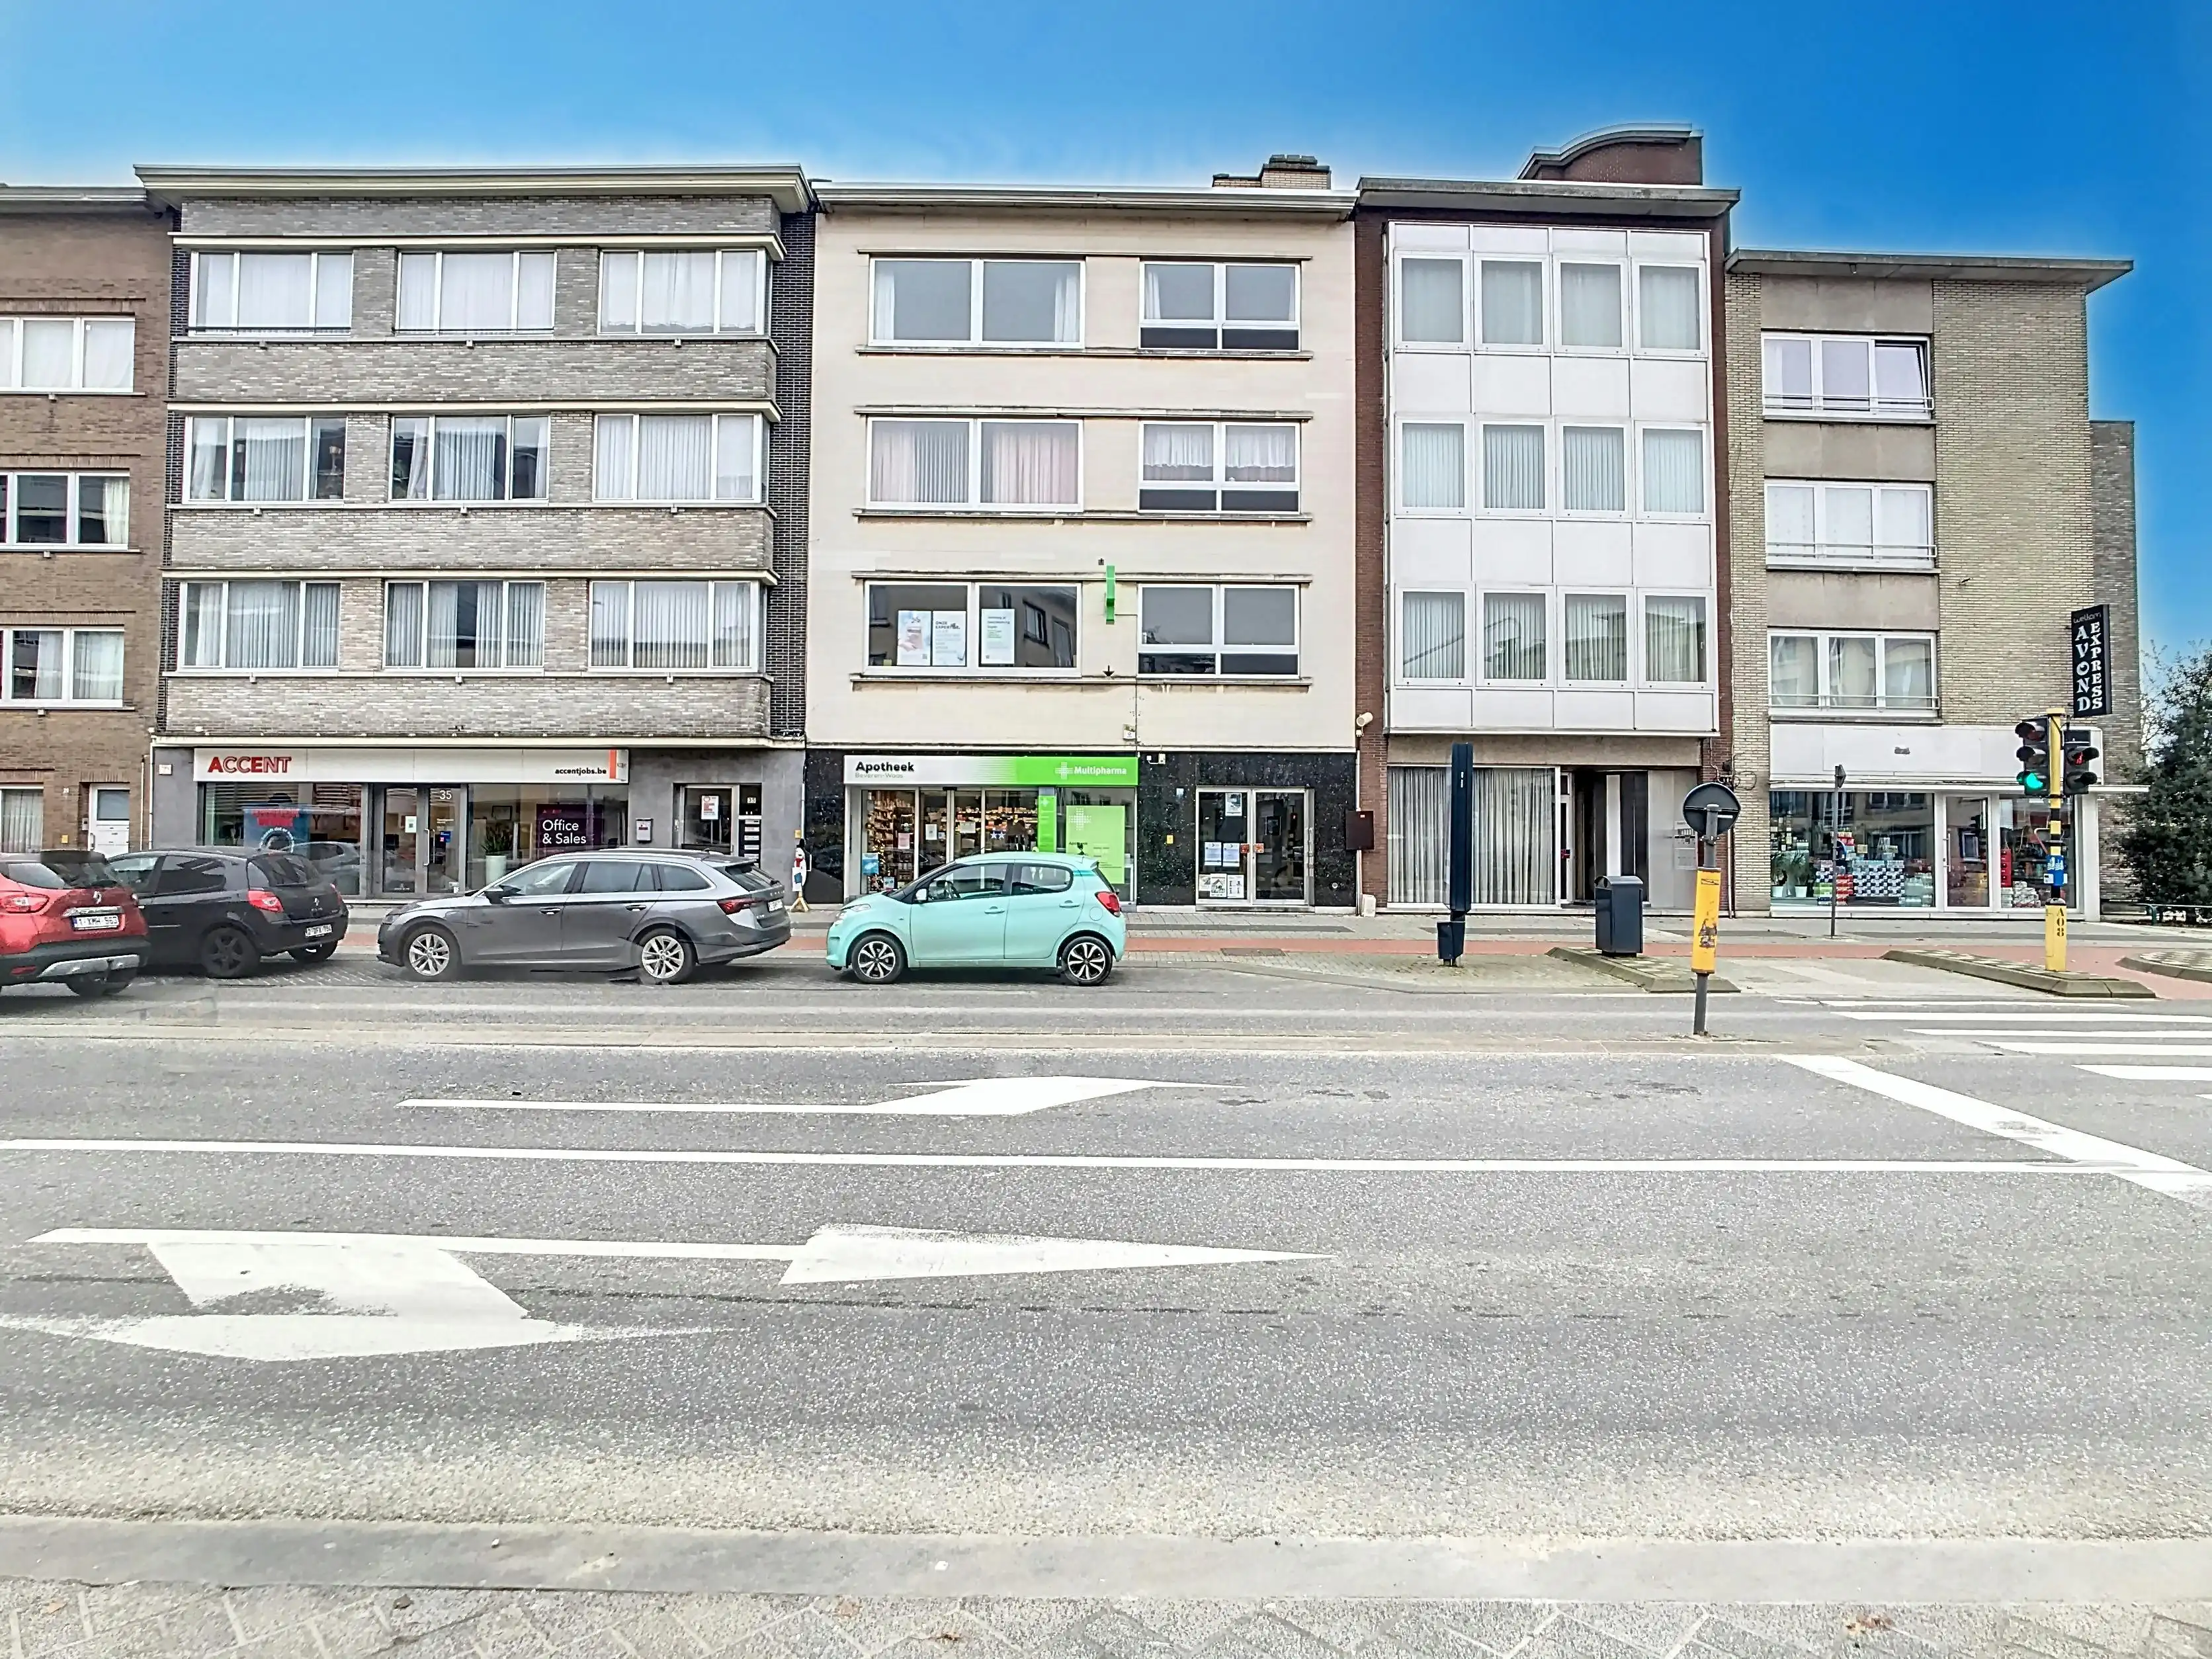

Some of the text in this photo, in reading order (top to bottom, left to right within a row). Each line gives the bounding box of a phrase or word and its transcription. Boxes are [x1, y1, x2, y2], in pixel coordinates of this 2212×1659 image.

[2075, 625, 2091, 712] AVOND
[2090, 622, 2104, 710] EXPRESS
[207, 756, 292, 773] ACCENT
[855, 761, 914, 773] Apotheek
[555, 767, 607, 776] accentjobs.be
[1074, 766, 1127, 776] Multipharma
[439, 790, 452, 800] 35
[542, 819, 579, 831] Office
[542, 832, 587, 844] & Sales
